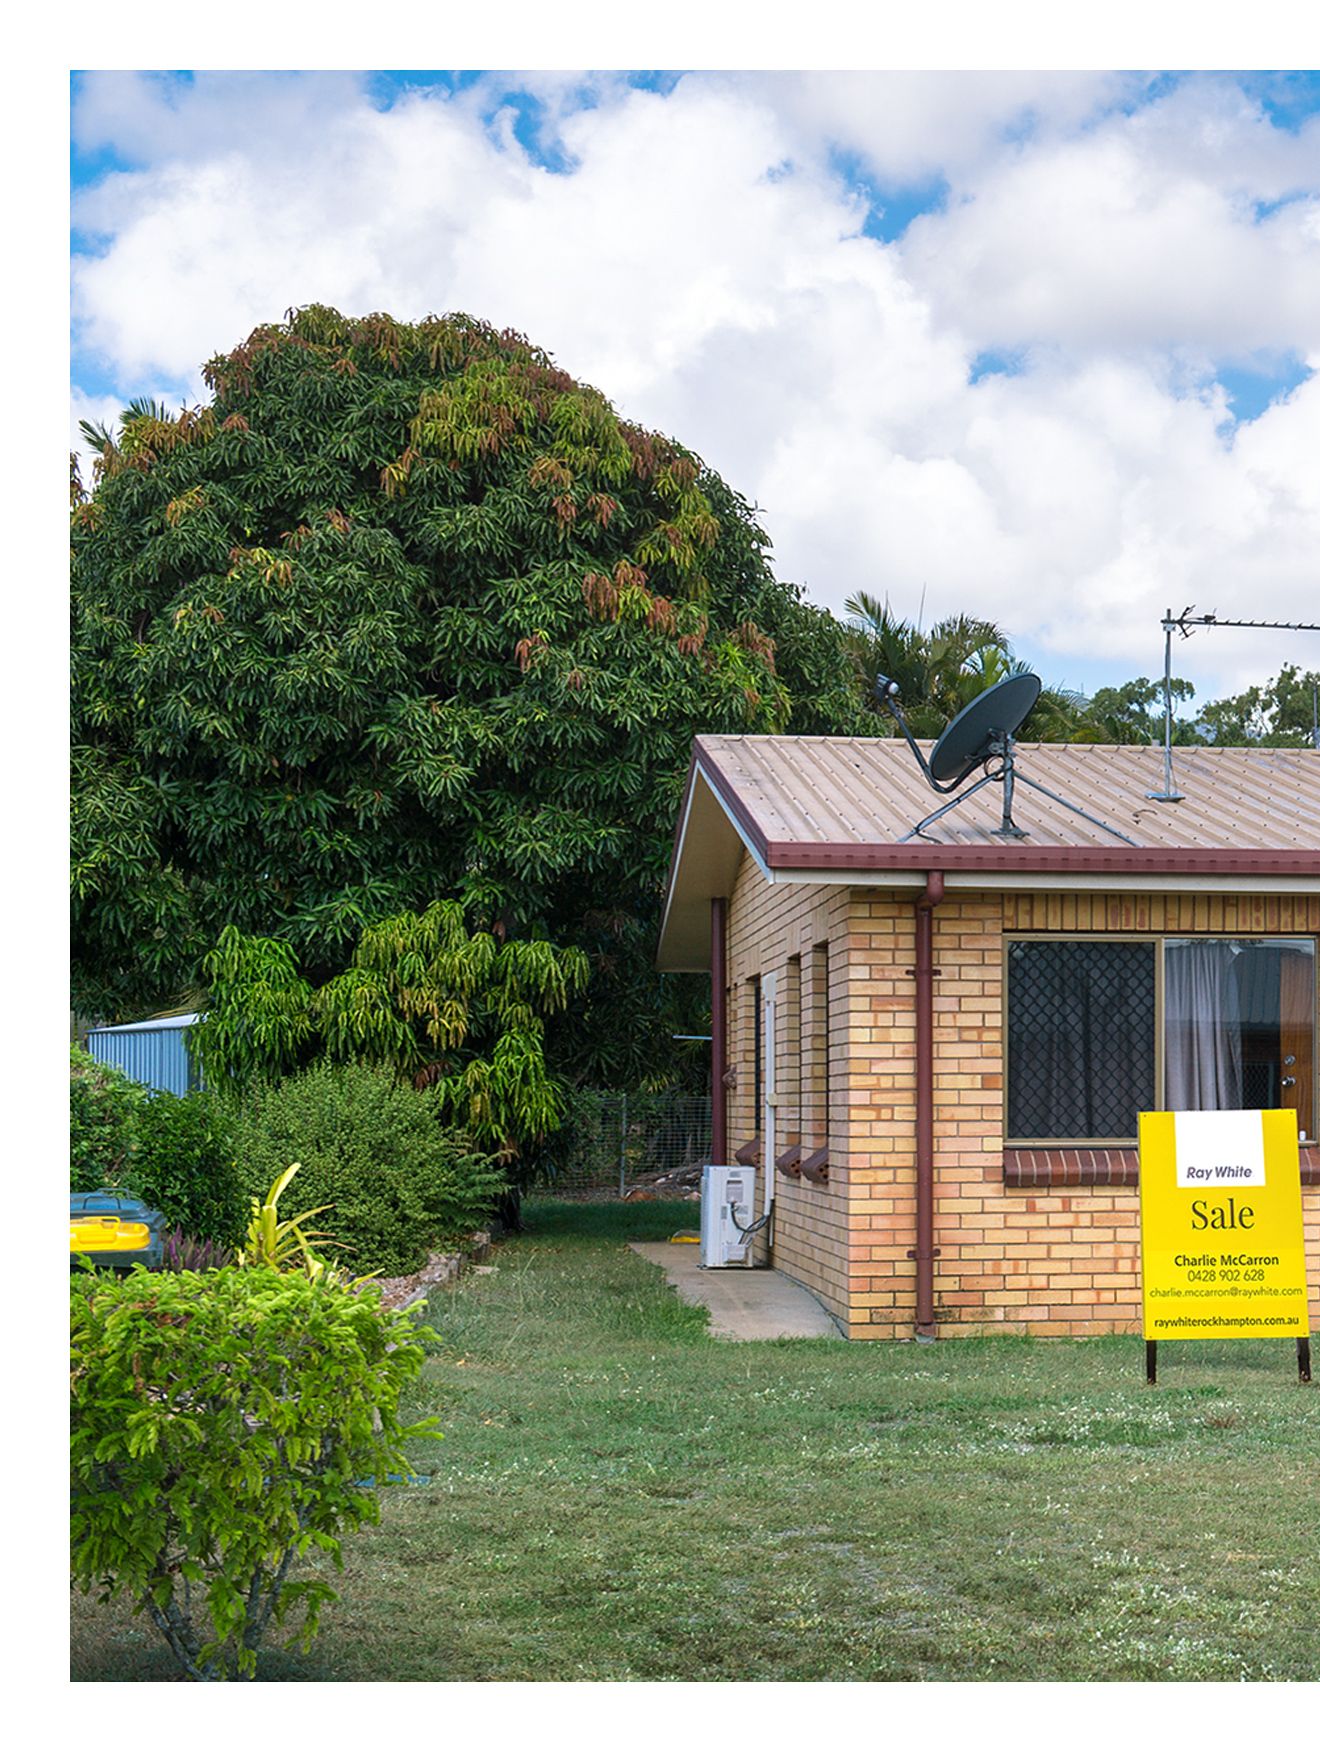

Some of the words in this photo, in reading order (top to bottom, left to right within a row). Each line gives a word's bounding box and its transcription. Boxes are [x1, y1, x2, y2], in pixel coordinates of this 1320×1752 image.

[1186, 1166, 1213, 1181] Ray
[1215, 1165, 1253, 1178] White
[1191, 1198, 1255, 1231] Sale
[1174, 1254, 1217, 1267] Charlie
[1220, 1254, 1280, 1266] McCarron
[1187, 1269, 1216, 1282] 0428
[1219, 1269, 1241, 1282] 902
[1243, 1268, 1265, 1282] 628
[1149, 1286, 1303, 1299] charlie.mccarron@raywhite.com
[1154, 1315, 1300, 1329] raywhiterockhampton.com.au
